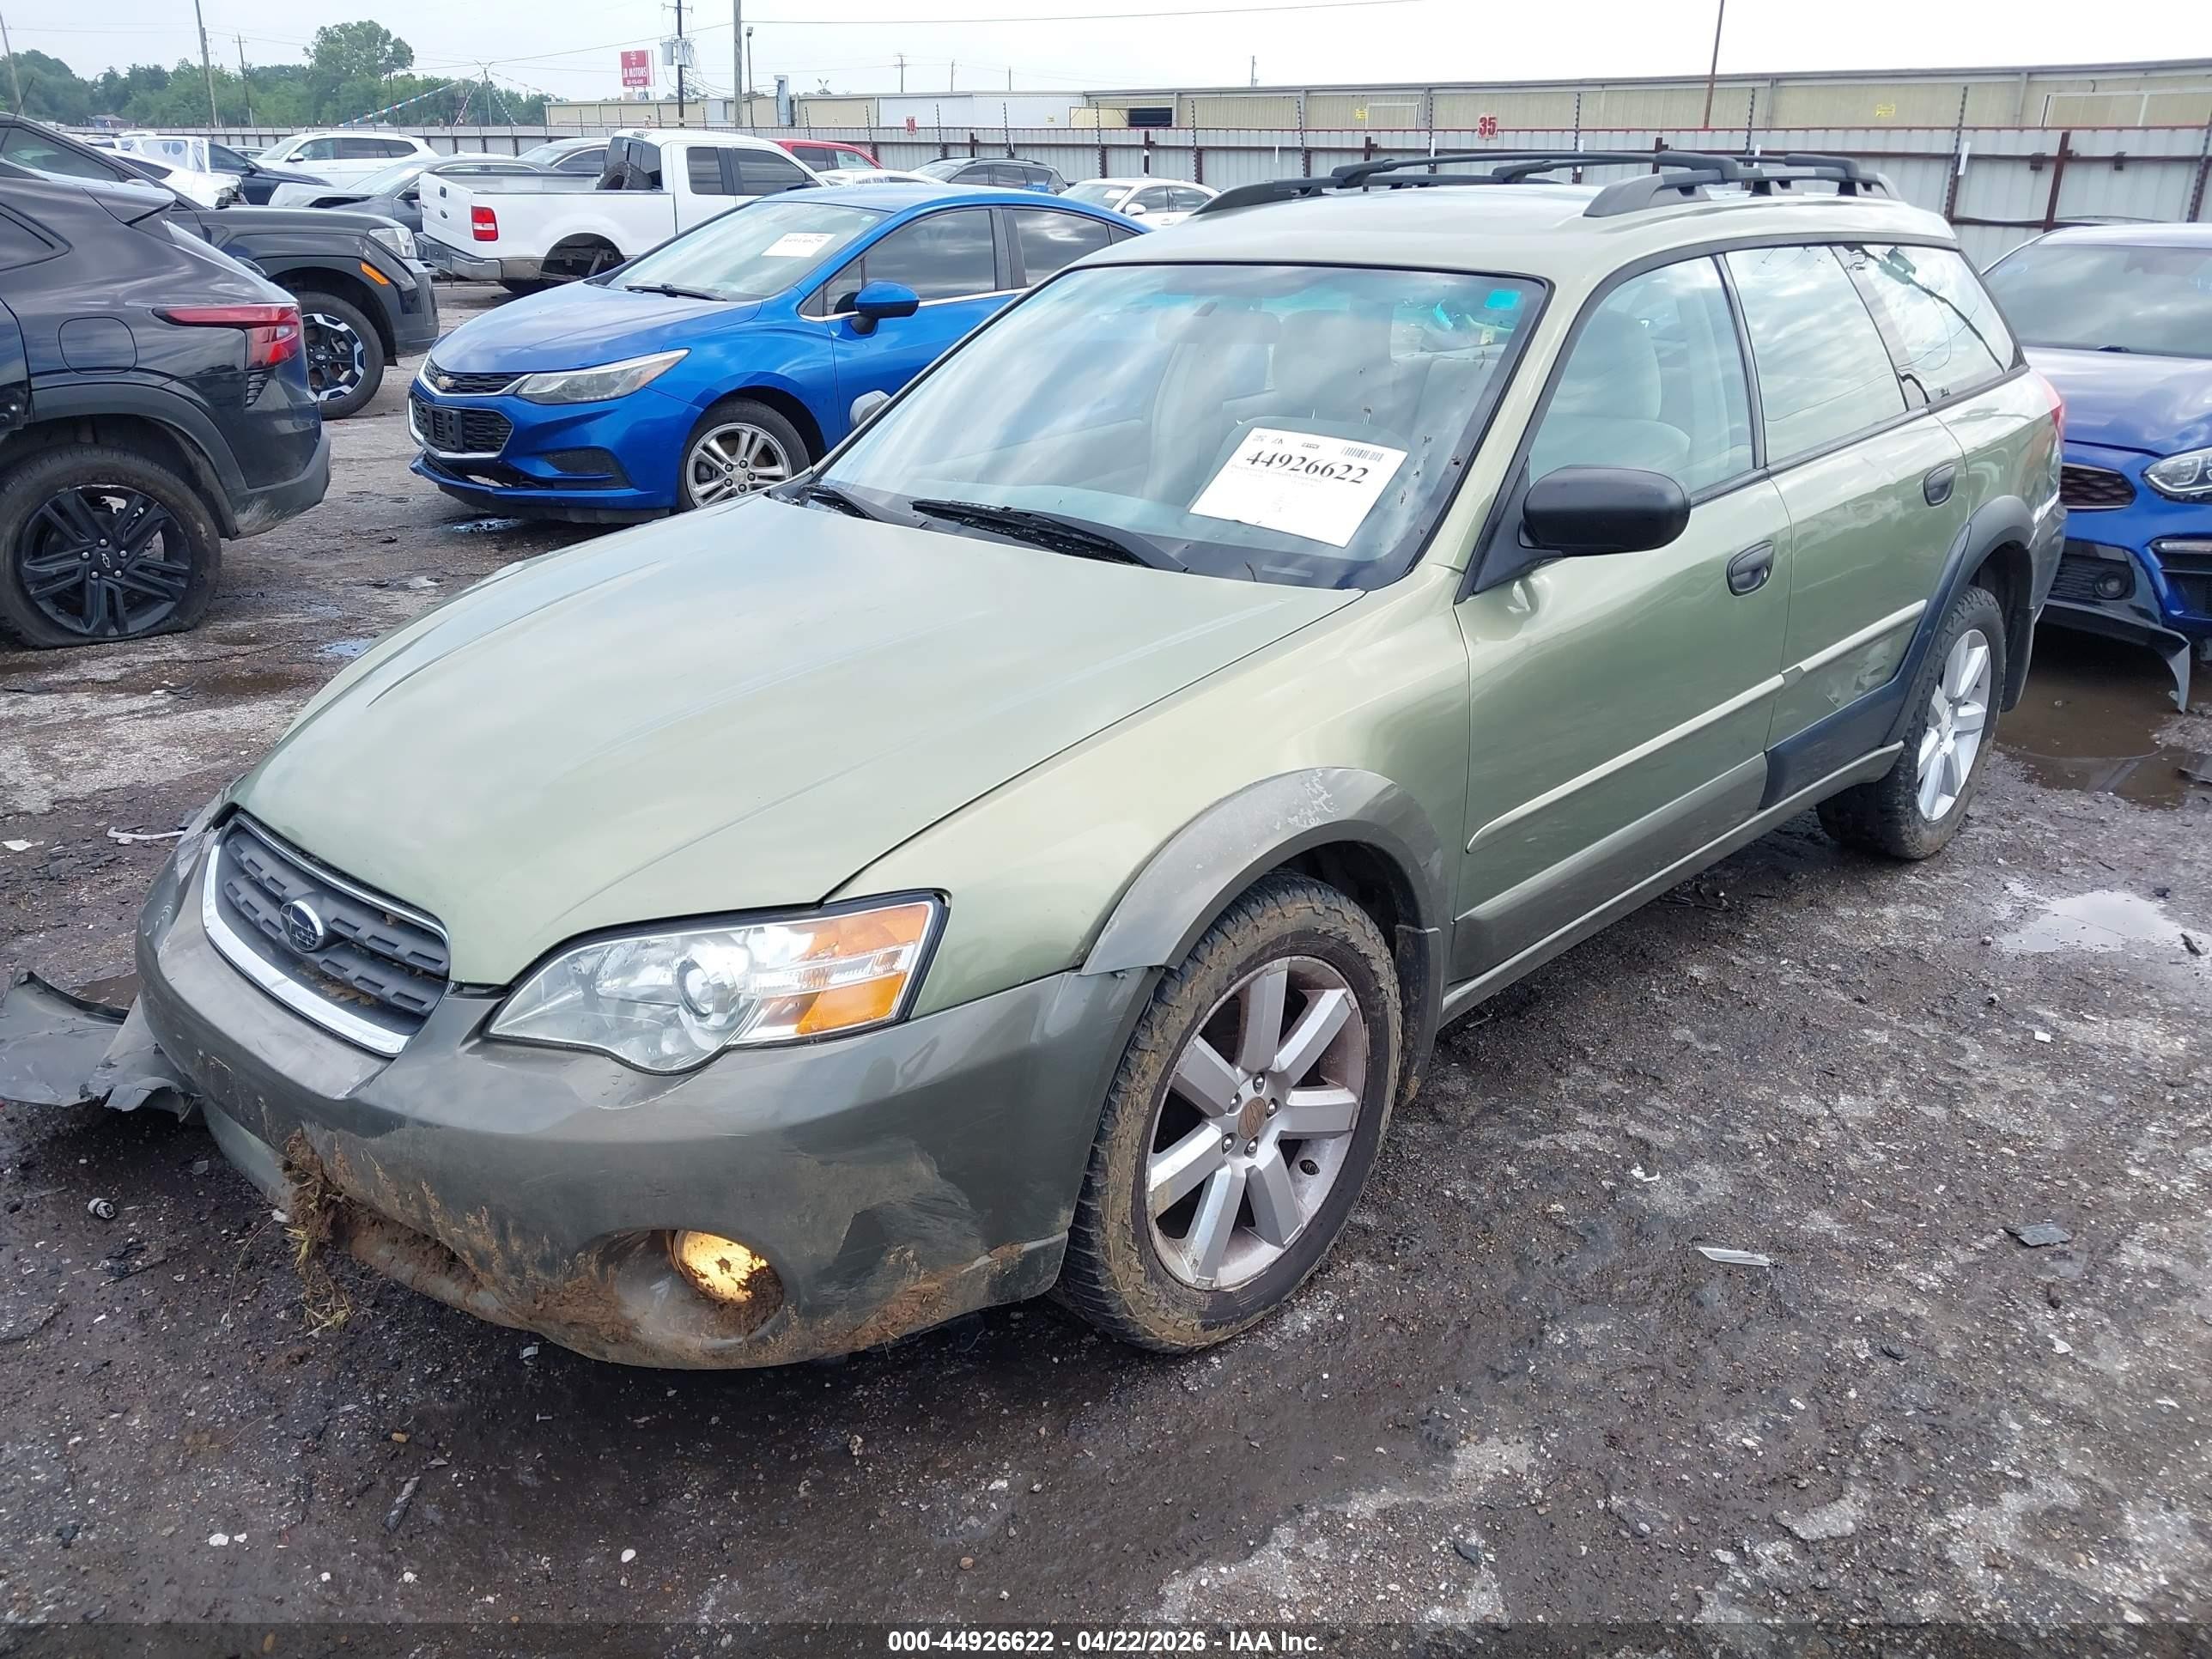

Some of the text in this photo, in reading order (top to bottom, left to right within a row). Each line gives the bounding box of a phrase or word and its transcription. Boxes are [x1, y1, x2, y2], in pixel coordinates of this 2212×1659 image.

[629, 67, 647, 78] MOTORS
[906, 118, 915, 132] 30
[1479, 117, 1497, 136] 35
[1246, 450, 1369, 484] 44926622
